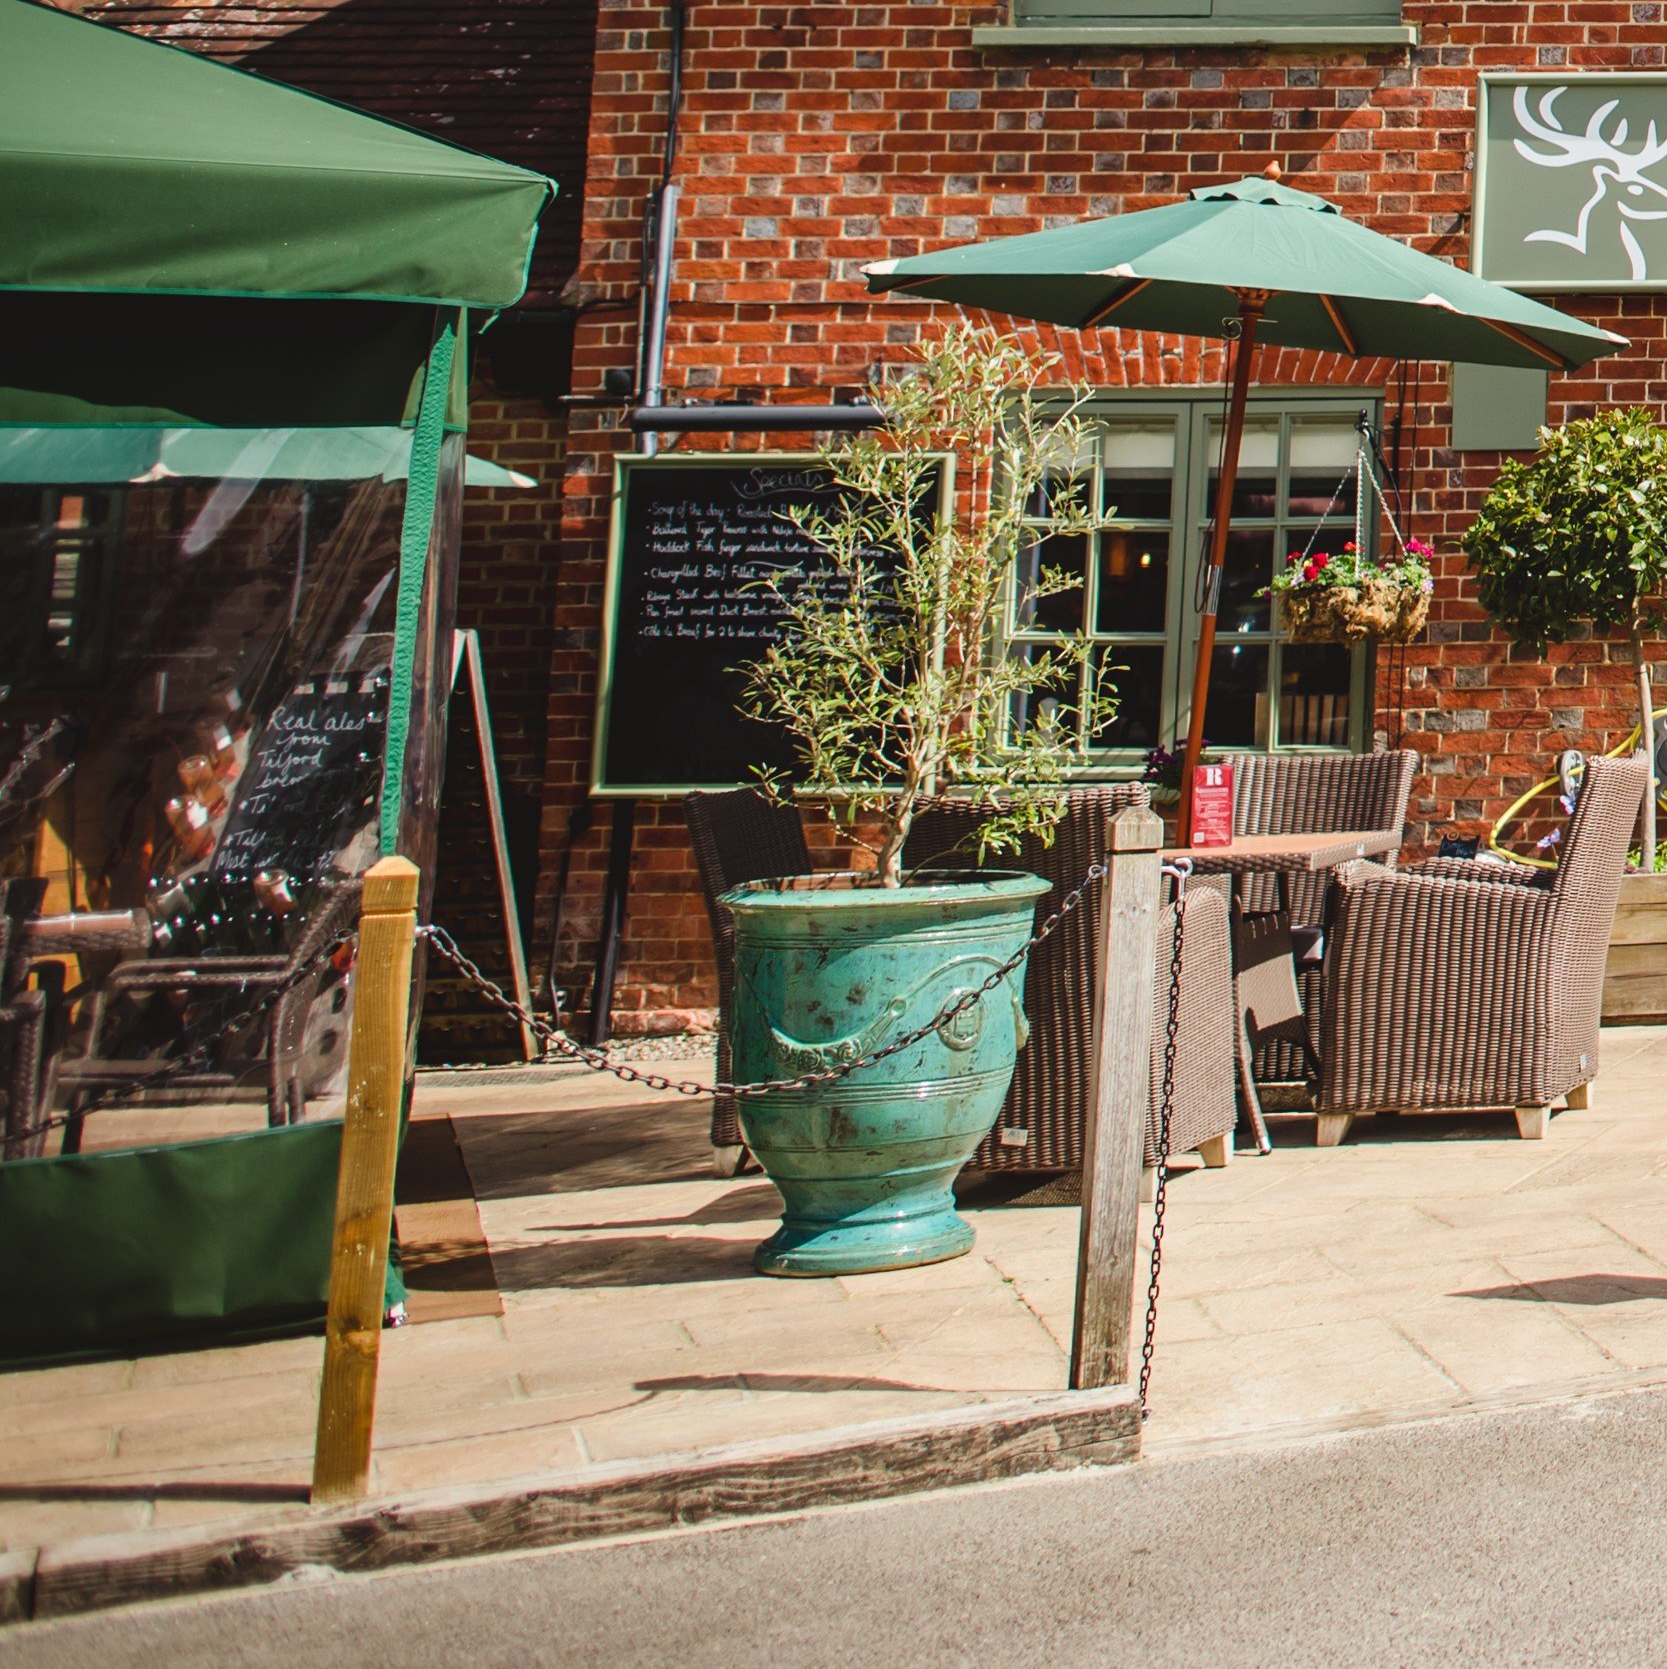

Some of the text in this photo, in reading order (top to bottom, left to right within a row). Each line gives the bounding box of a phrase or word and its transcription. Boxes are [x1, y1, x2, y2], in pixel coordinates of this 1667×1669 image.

[267, 706, 365, 732] Real ales
[277, 732, 332, 753] from
[257, 748, 323, 776] Tilford
